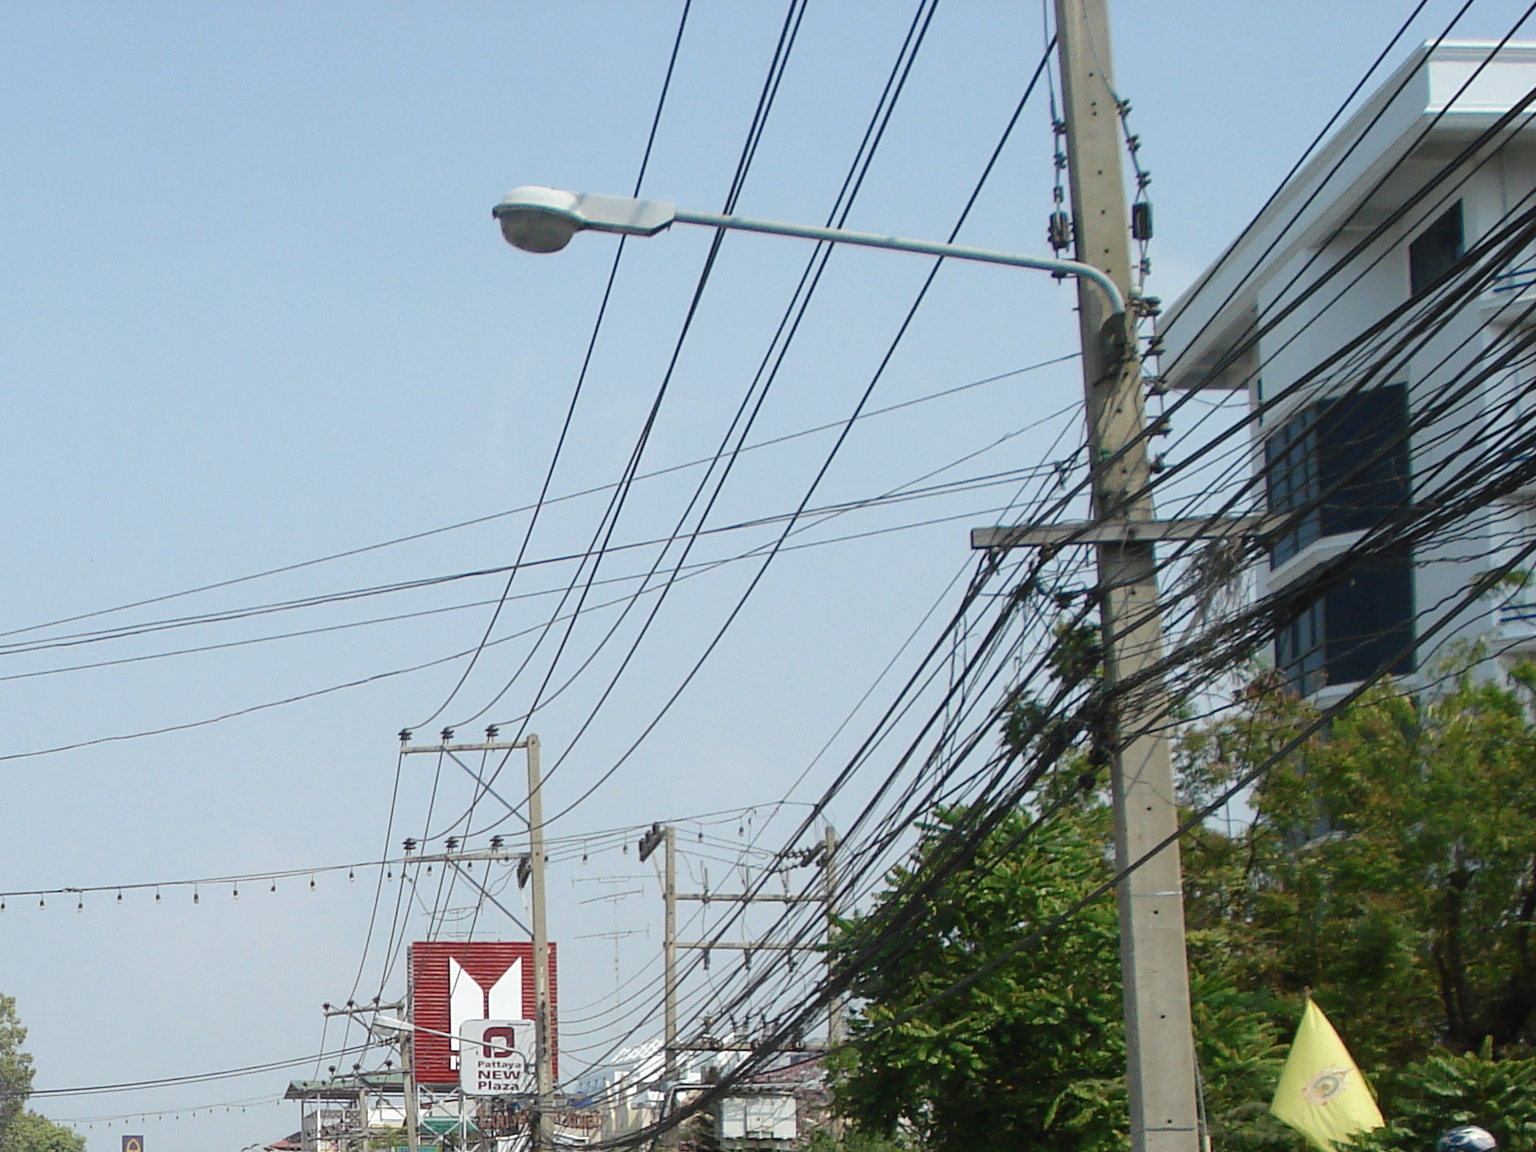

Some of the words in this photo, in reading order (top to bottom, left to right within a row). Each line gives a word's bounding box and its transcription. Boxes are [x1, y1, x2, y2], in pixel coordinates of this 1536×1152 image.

[477, 1060, 522, 1071] Pattaya
[477, 1070, 521, 1080] NEW
[477, 1081, 520, 1091] Plaza
